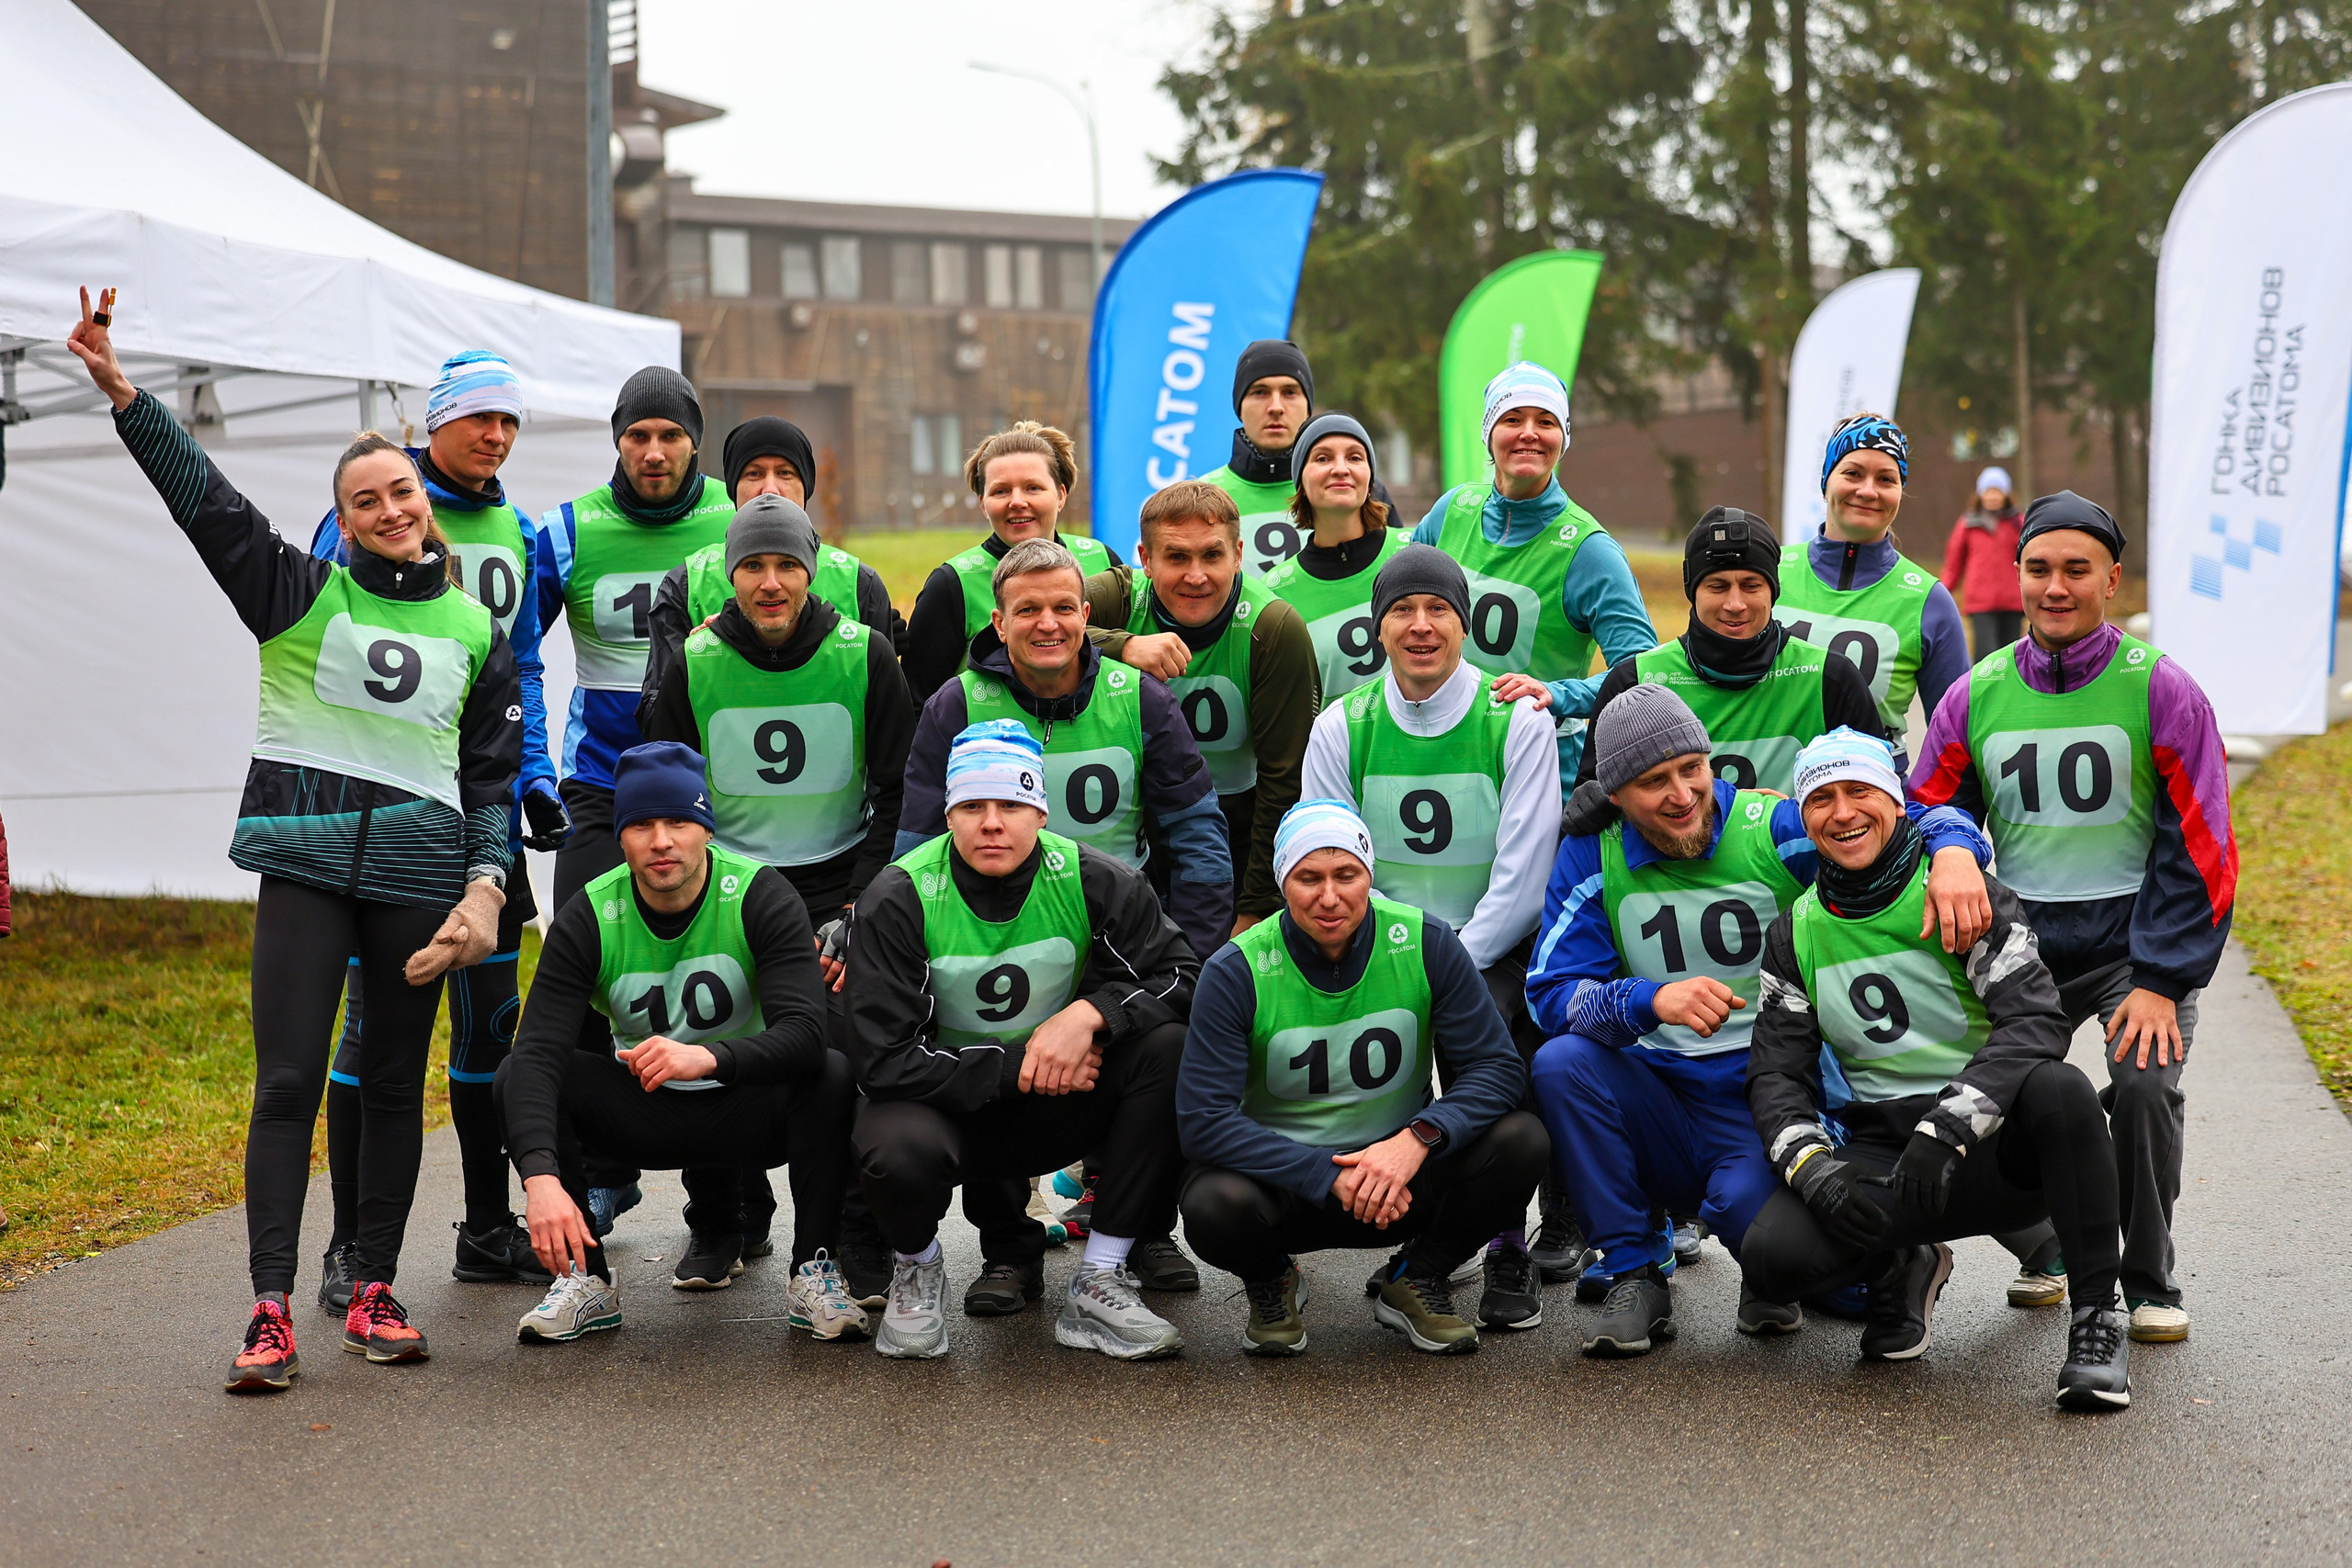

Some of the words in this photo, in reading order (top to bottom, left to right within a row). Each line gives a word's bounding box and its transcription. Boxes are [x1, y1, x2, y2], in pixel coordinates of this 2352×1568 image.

[1139, 301, 1216, 505] САТОМ
[2240, 266, 2284, 496] ДИВИЗИОНОВ
[2266, 322, 2307, 497] РОСАТОМА
[2211, 386, 2244, 496] ГОНКА
[1255, 523, 1301, 573] 9
[364, 639, 422, 703] 9
[1338, 616, 1387, 676] 9
[1769, 664, 1819, 679] РОСАТОМ
[1107, 688, 1133, 697] РОСАТОМ
[753, 720, 806, 784] 9
[2001, 740, 2112, 813] 10
[1399, 789, 1453, 854] 9
[1046, 871, 1074, 882] РОСАТОМ
[1387, 944, 1416, 954] РОСАТОМ
[1640, 898, 1761, 974] 10
[630, 970, 733, 1033] 10
[976, 963, 1029, 1021] 9
[1849, 973, 1910, 1044] 9
[1289, 1027, 1402, 1095] 10
